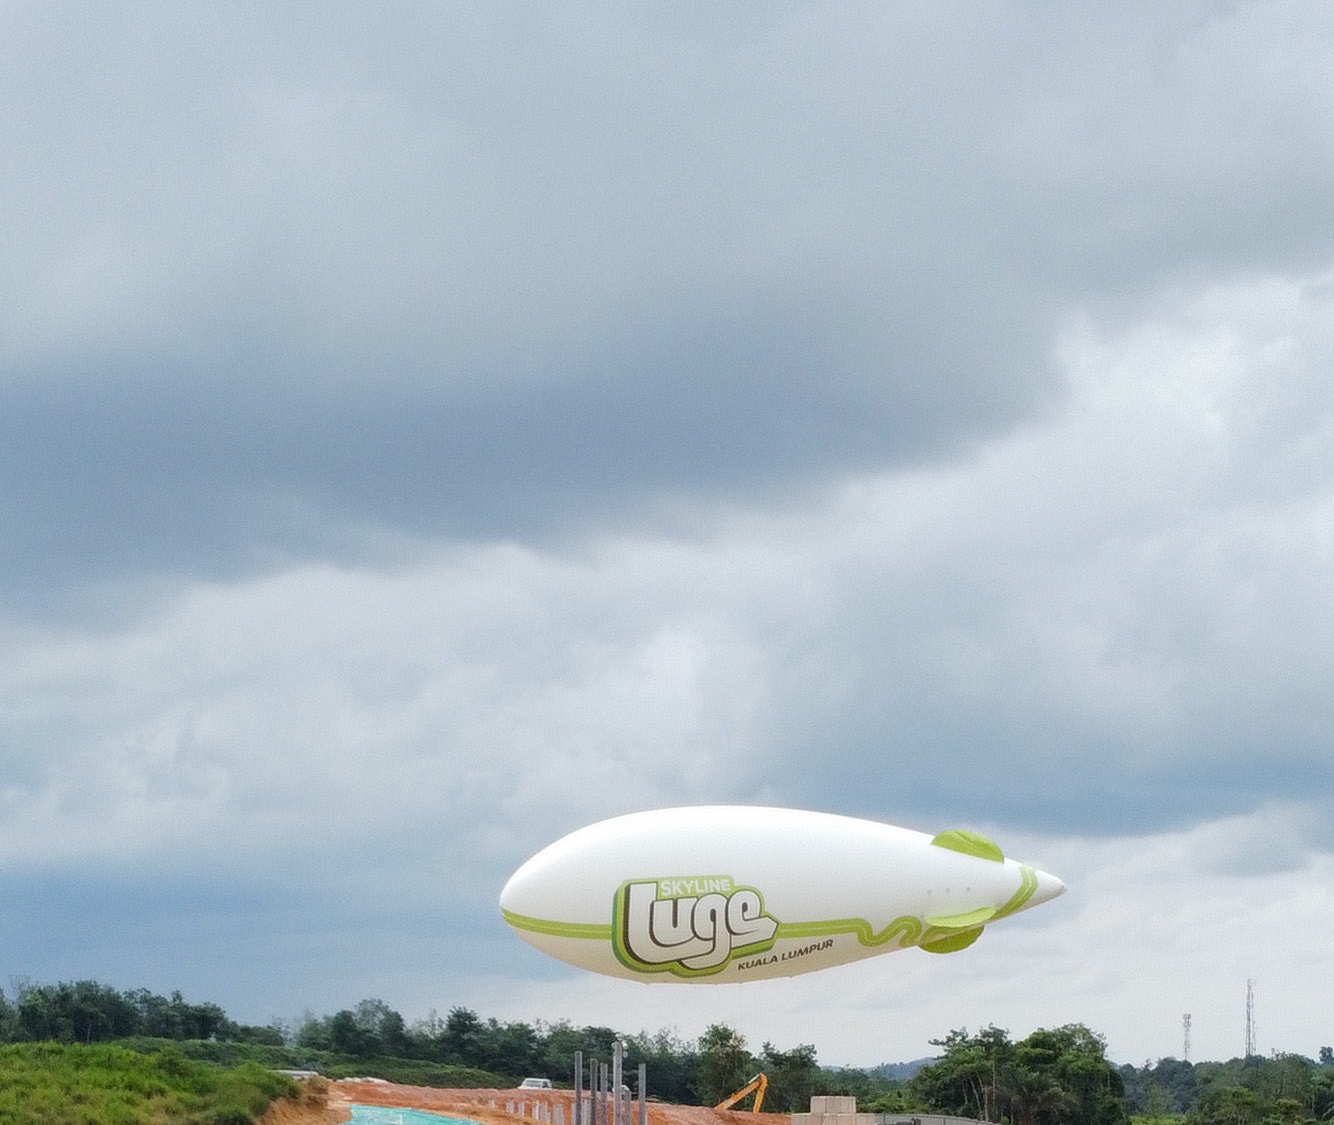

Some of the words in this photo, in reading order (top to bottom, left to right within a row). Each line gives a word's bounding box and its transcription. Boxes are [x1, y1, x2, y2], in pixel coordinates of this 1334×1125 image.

[661, 879, 732, 897] SKYLINE
[623, 881, 779, 970] Luge
[737, 954, 779, 972] KUALA
[781, 938, 835, 961] LUMPUR
